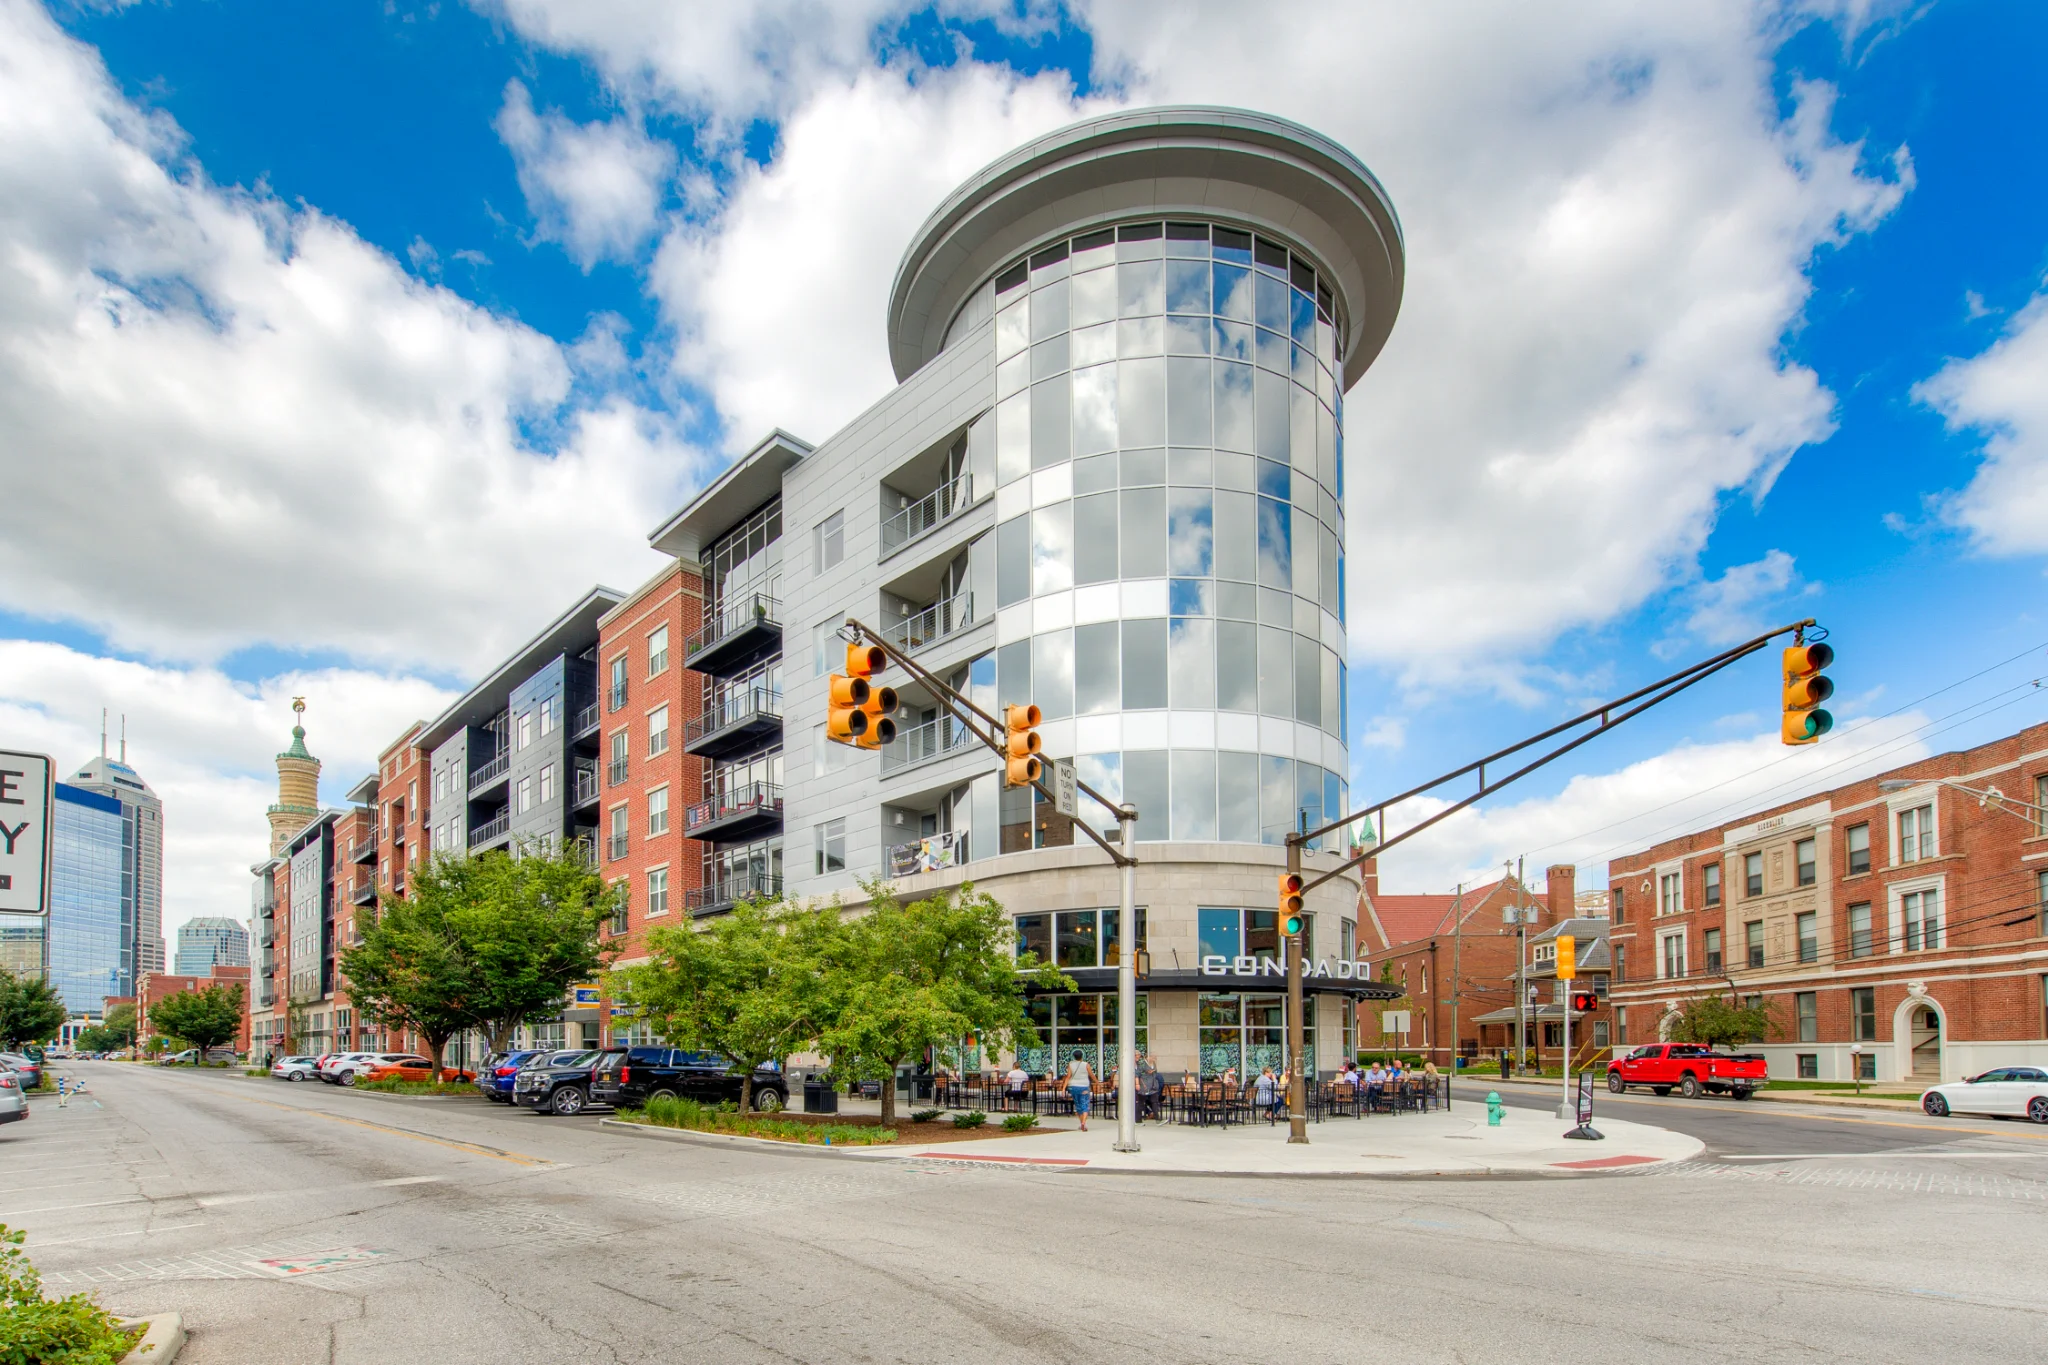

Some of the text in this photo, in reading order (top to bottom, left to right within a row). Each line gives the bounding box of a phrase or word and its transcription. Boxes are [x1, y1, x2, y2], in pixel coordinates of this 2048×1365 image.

[1060, 767, 1072, 779] NO
[1060, 779, 1074, 790] TURN
[1063, 791, 1072, 800] ON
[1062, 801, 1073, 812] RED
[1590, 995, 1597, 1009] 5
